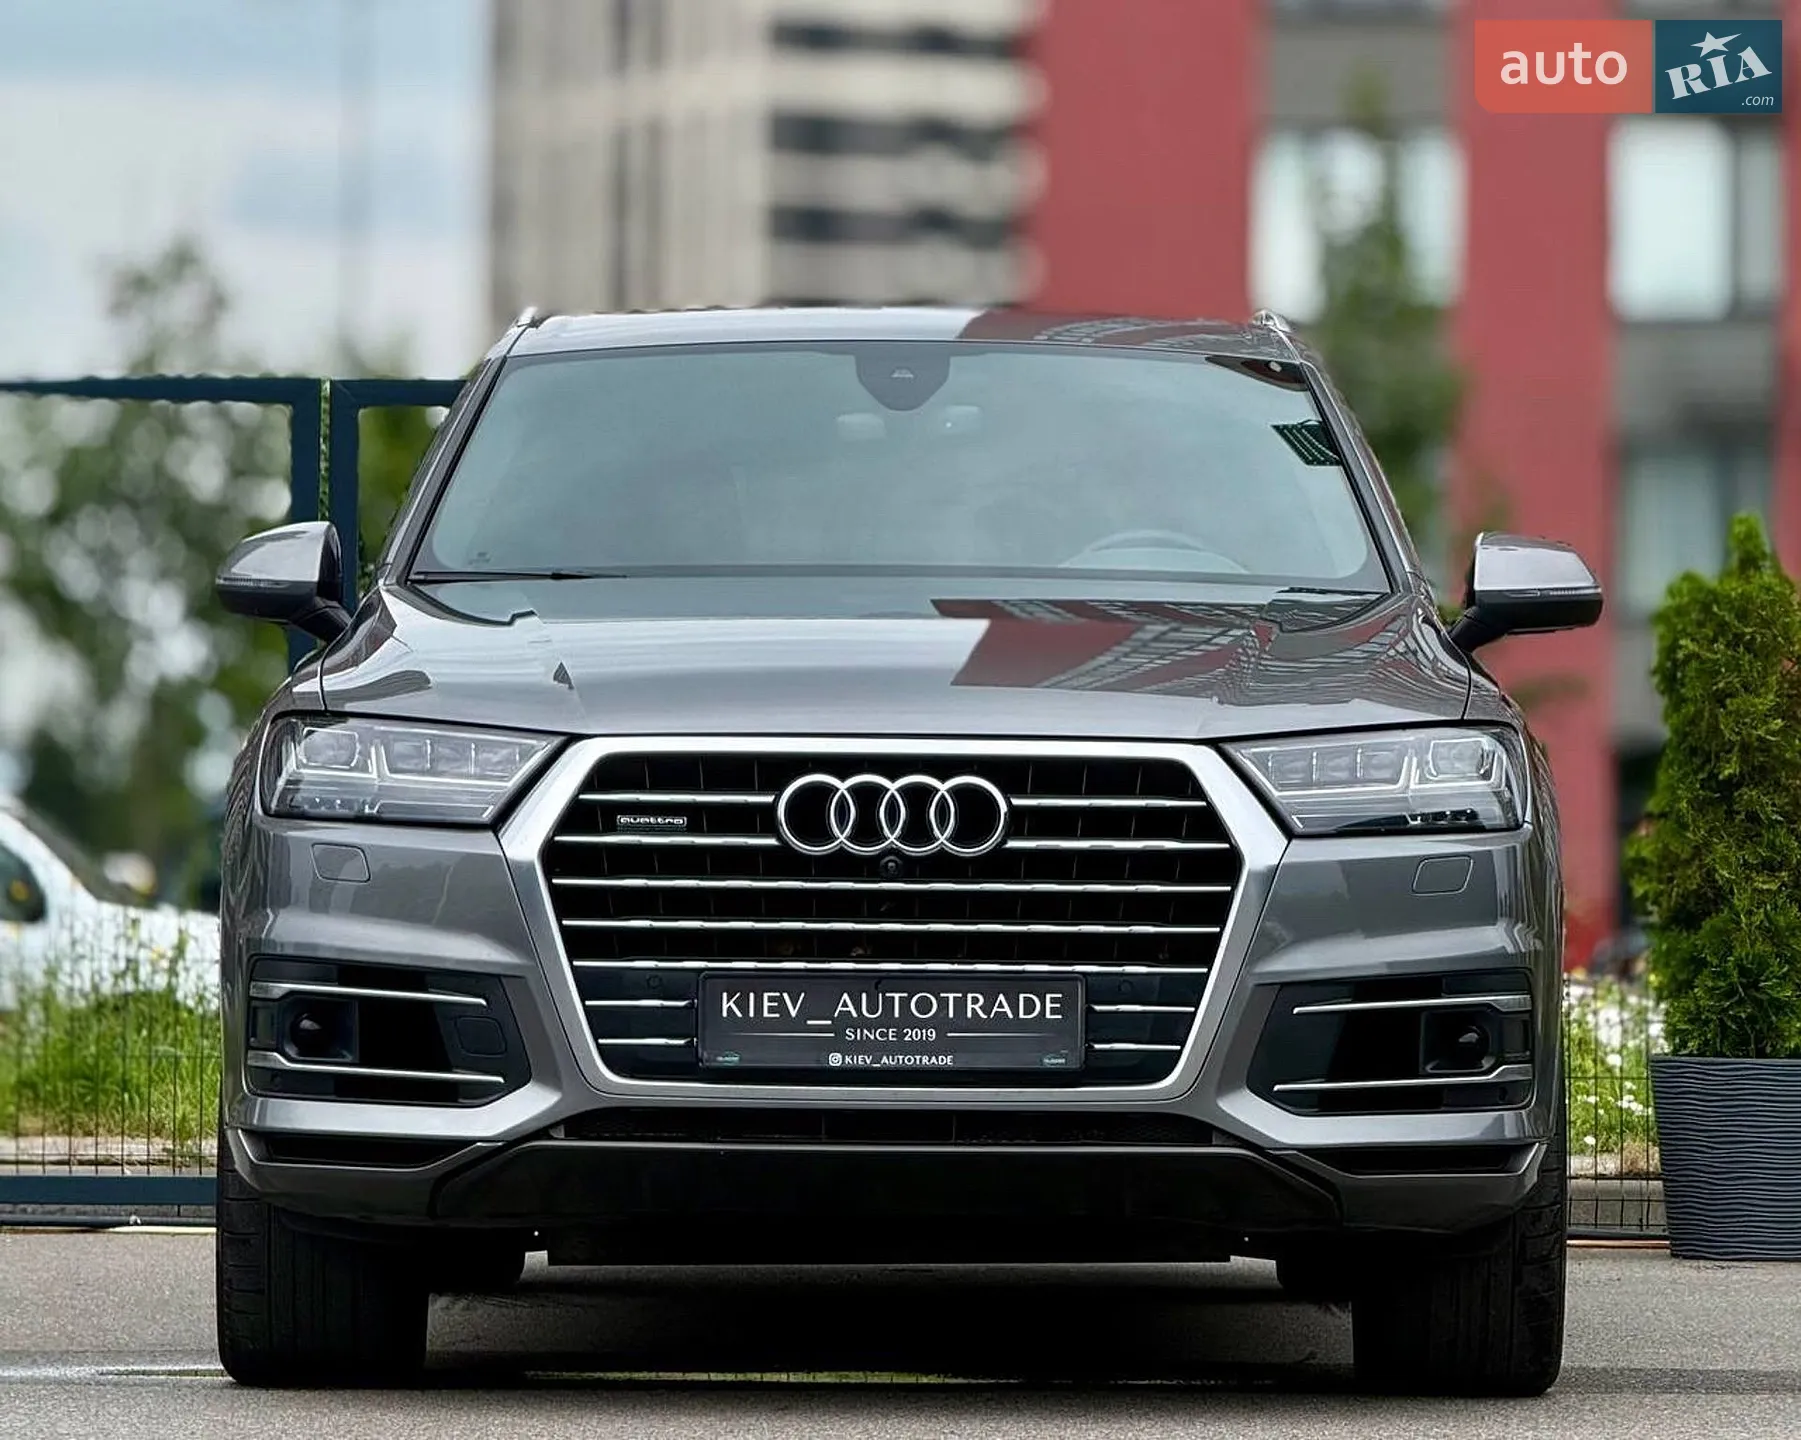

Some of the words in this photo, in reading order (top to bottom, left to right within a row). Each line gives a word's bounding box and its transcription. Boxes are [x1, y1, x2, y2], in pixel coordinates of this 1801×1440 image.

[619, 815, 685, 825] quattro
[721, 991, 1064, 1025] KIEV_AUTOTRADE
[845, 1027, 897, 1041] SINCE
[903, 1028, 936, 1041] 2019
[844, 1054, 954, 1067] KIEV_AUTOTRADE
